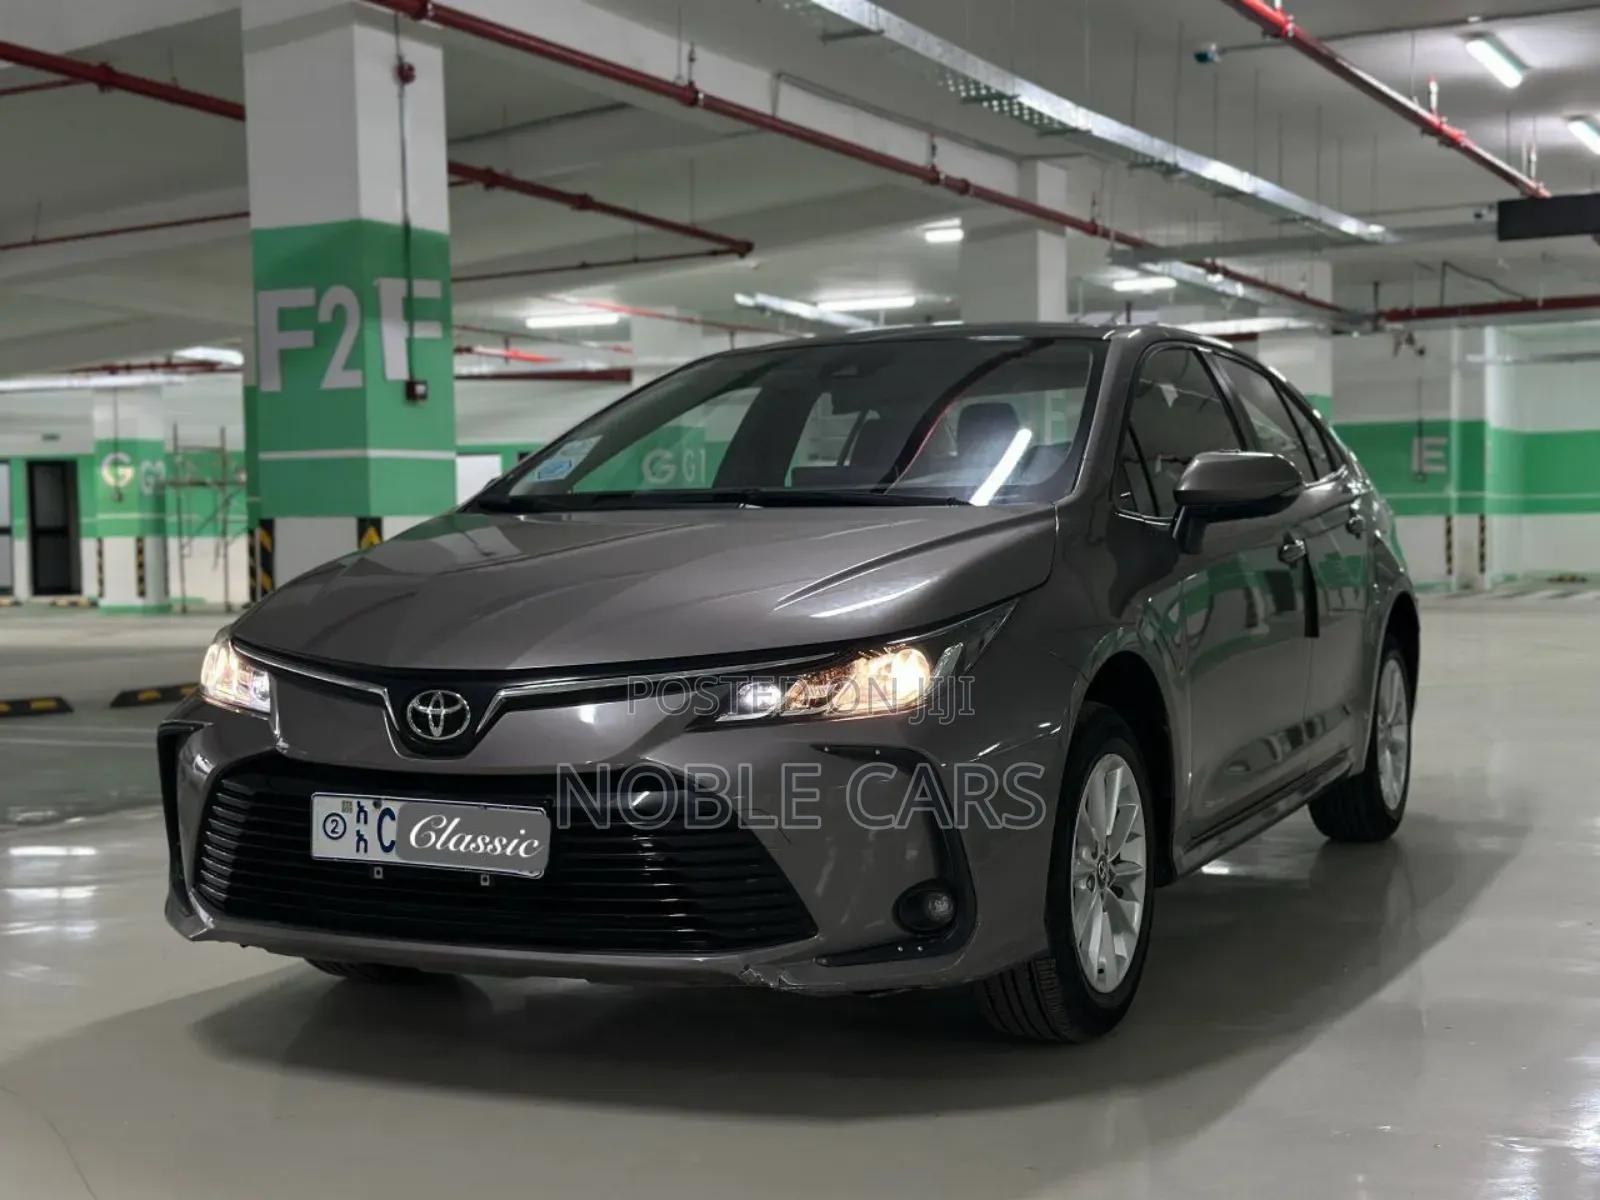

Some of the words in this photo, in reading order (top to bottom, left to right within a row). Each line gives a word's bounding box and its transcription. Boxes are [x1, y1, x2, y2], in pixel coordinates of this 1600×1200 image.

[258, 284, 363, 392] F2
[100, 452, 134, 487] G
[641, 448, 677, 484] G
[1411, 437, 1448, 473] E
